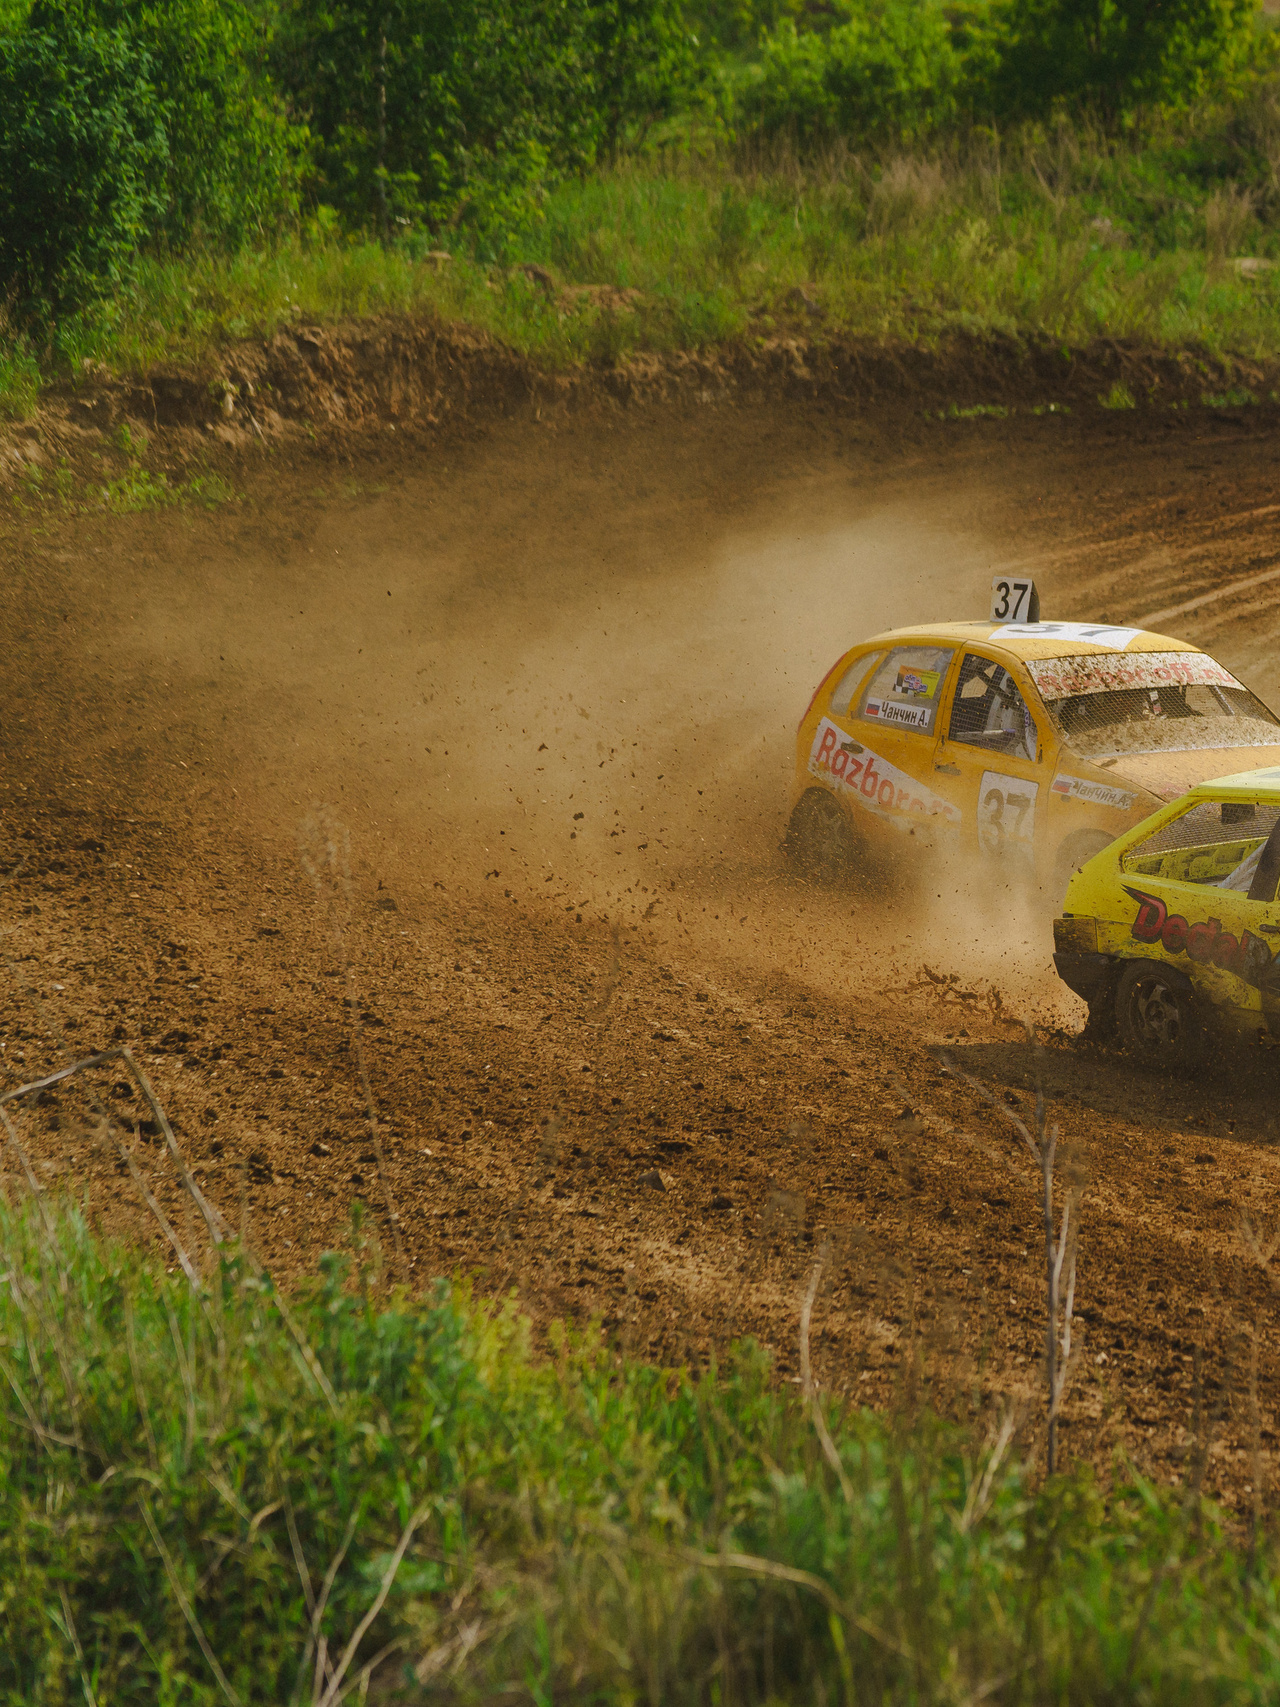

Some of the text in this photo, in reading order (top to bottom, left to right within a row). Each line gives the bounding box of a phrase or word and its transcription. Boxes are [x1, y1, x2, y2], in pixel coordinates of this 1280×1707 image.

[994, 581, 1029, 620] 37
[880, 701, 929, 727] Чанчин А.
[1073, 781, 1117, 802] Чанчин
[983, 788, 1031, 853] 37
[1122, 884, 1252, 970] Dedal
